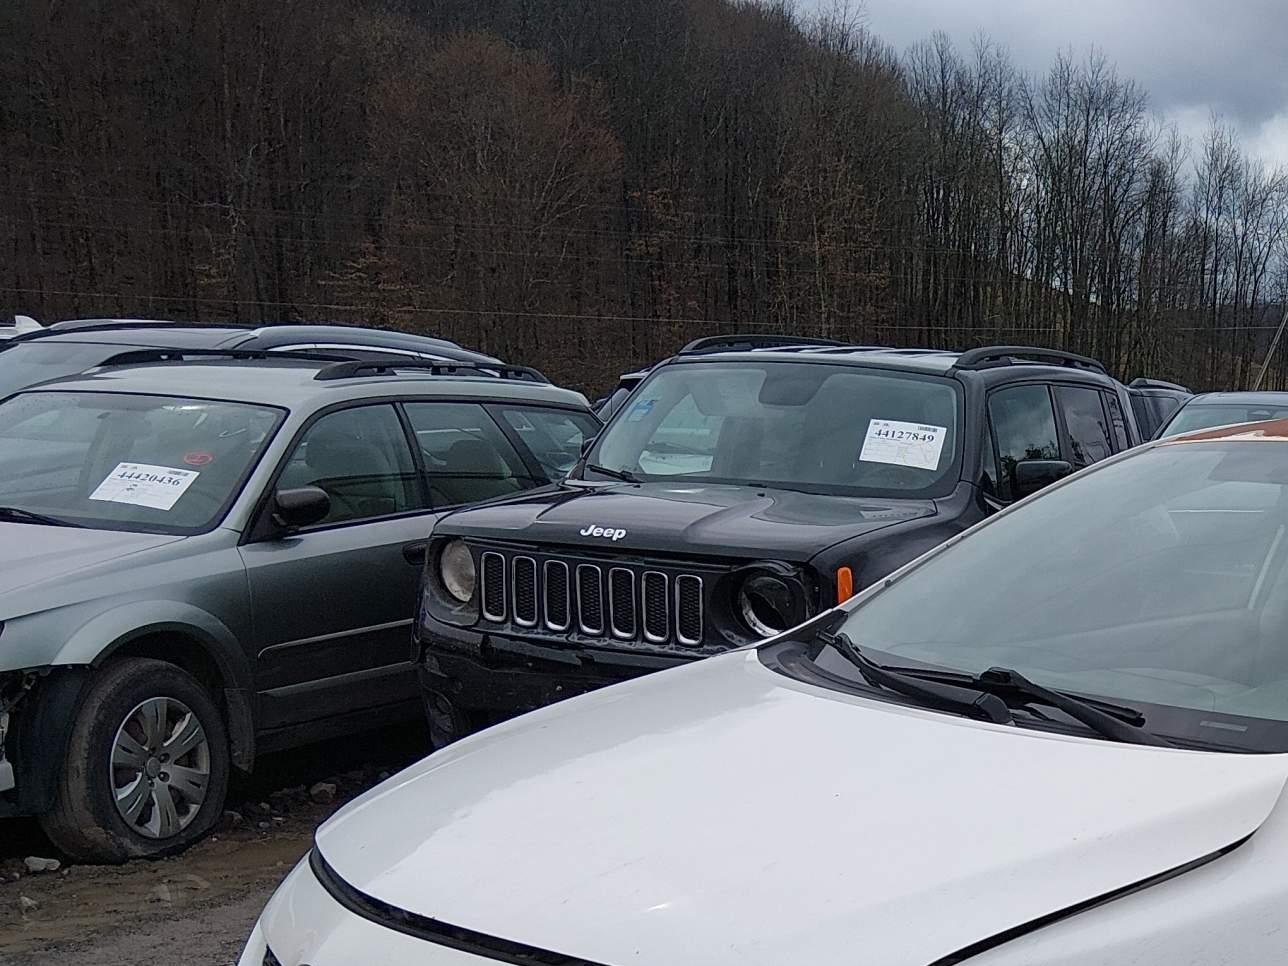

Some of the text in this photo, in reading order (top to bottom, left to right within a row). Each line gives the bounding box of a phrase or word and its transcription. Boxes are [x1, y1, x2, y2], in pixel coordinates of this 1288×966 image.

[873, 428, 935, 443] 44127849
[117, 471, 182, 487] 44420436
[579, 524, 627, 541] Jeep
